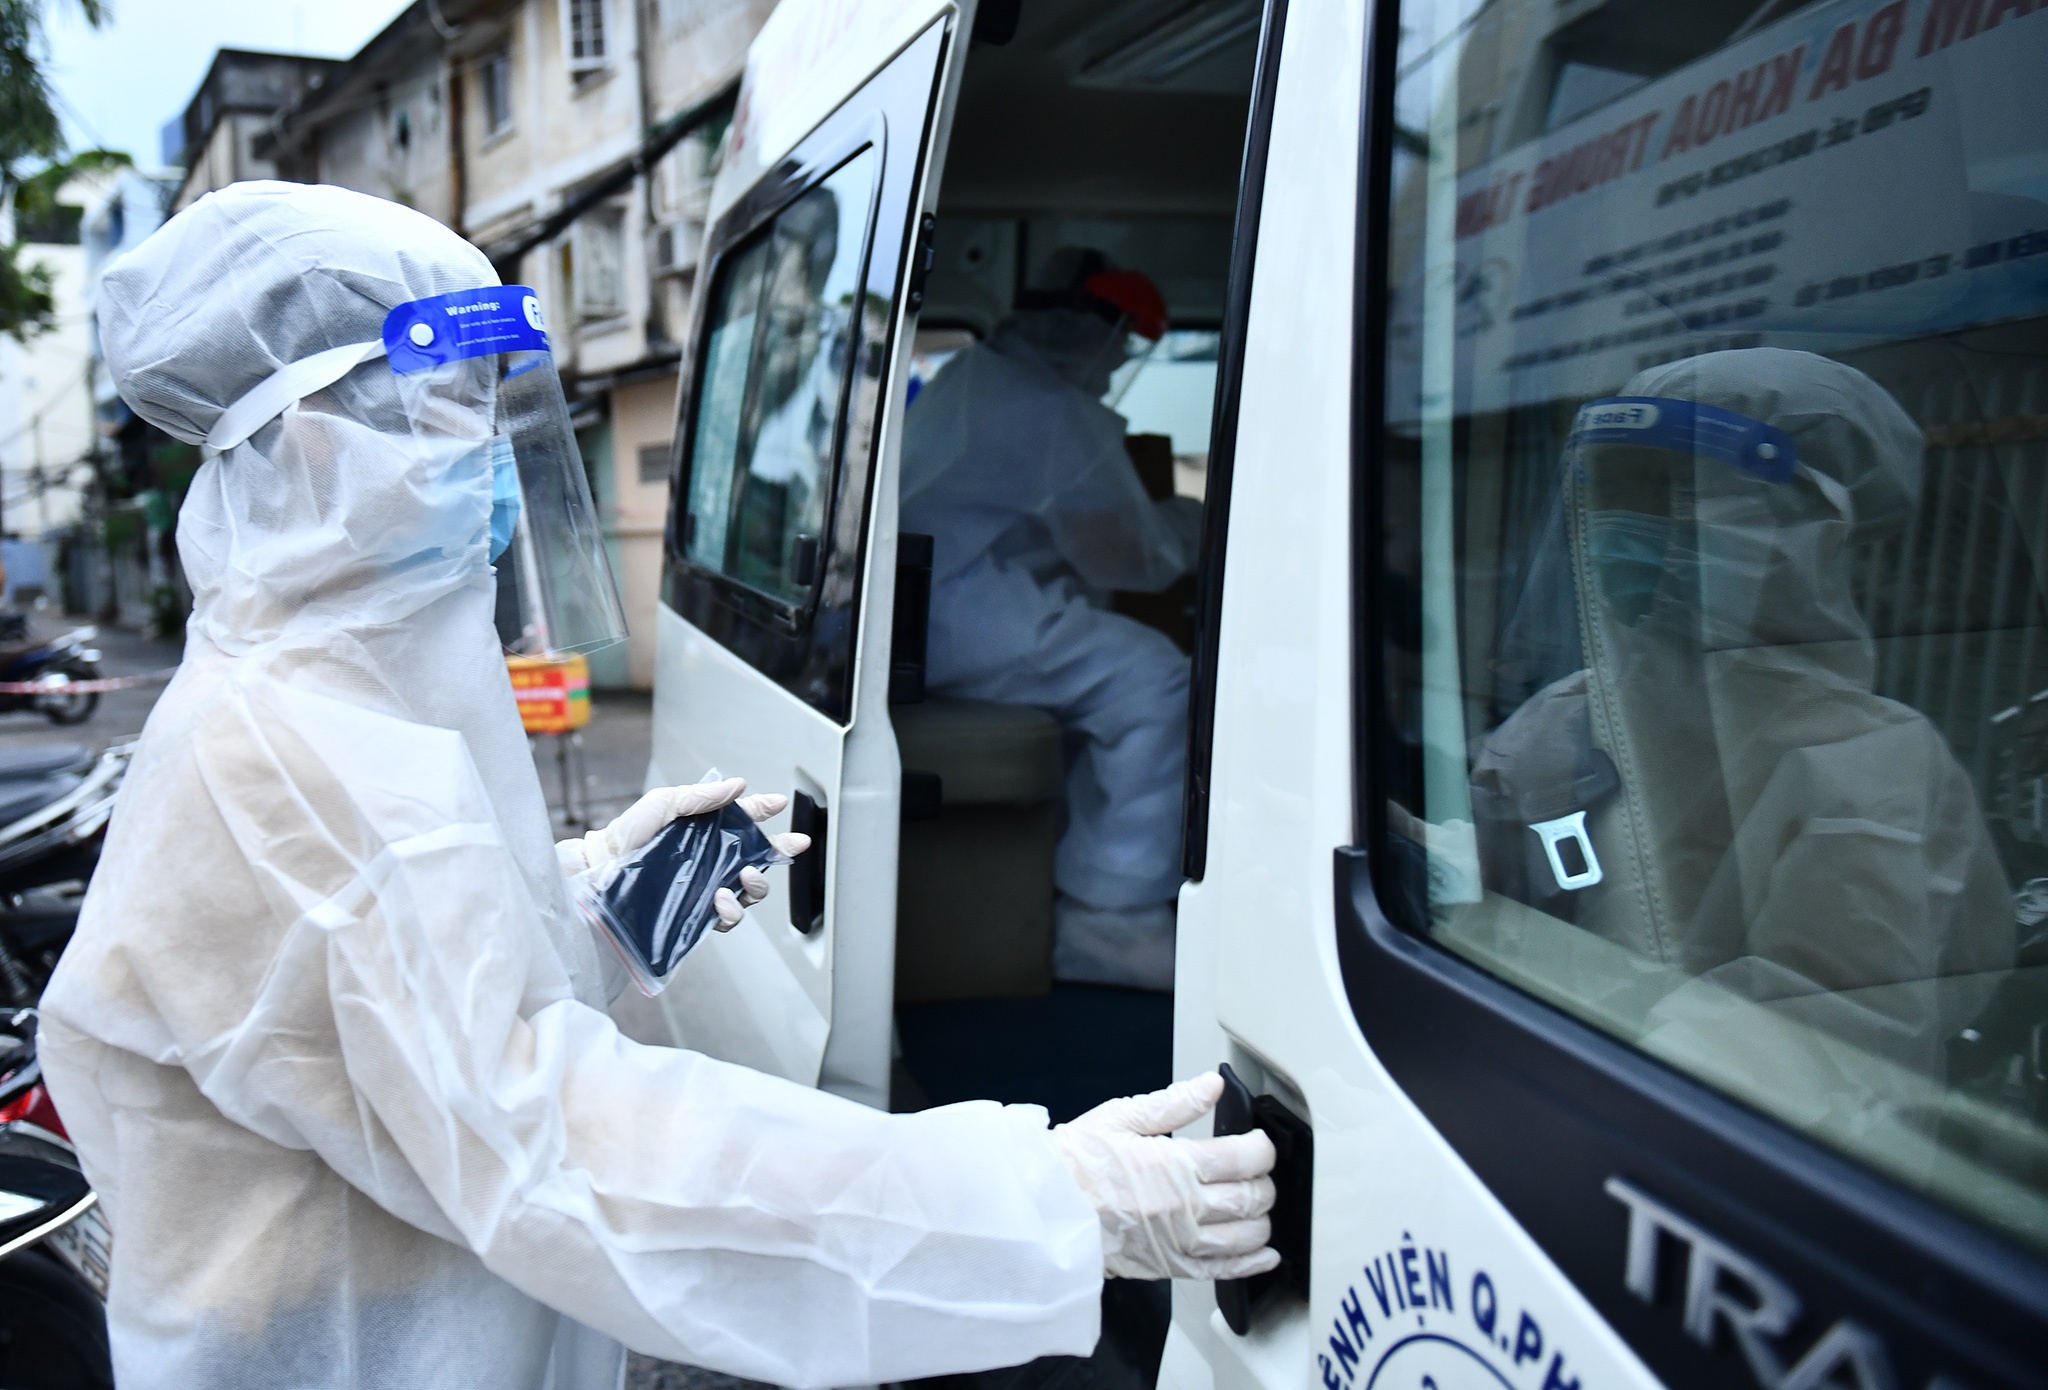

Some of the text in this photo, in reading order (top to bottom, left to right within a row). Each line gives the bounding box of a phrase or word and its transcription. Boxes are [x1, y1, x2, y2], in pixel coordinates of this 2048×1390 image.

[445, 300, 501, 317] Warning:
[1363, 1229, 1455, 1328] VIỆN
[1603, 1175, 1958, 1390] TRA
